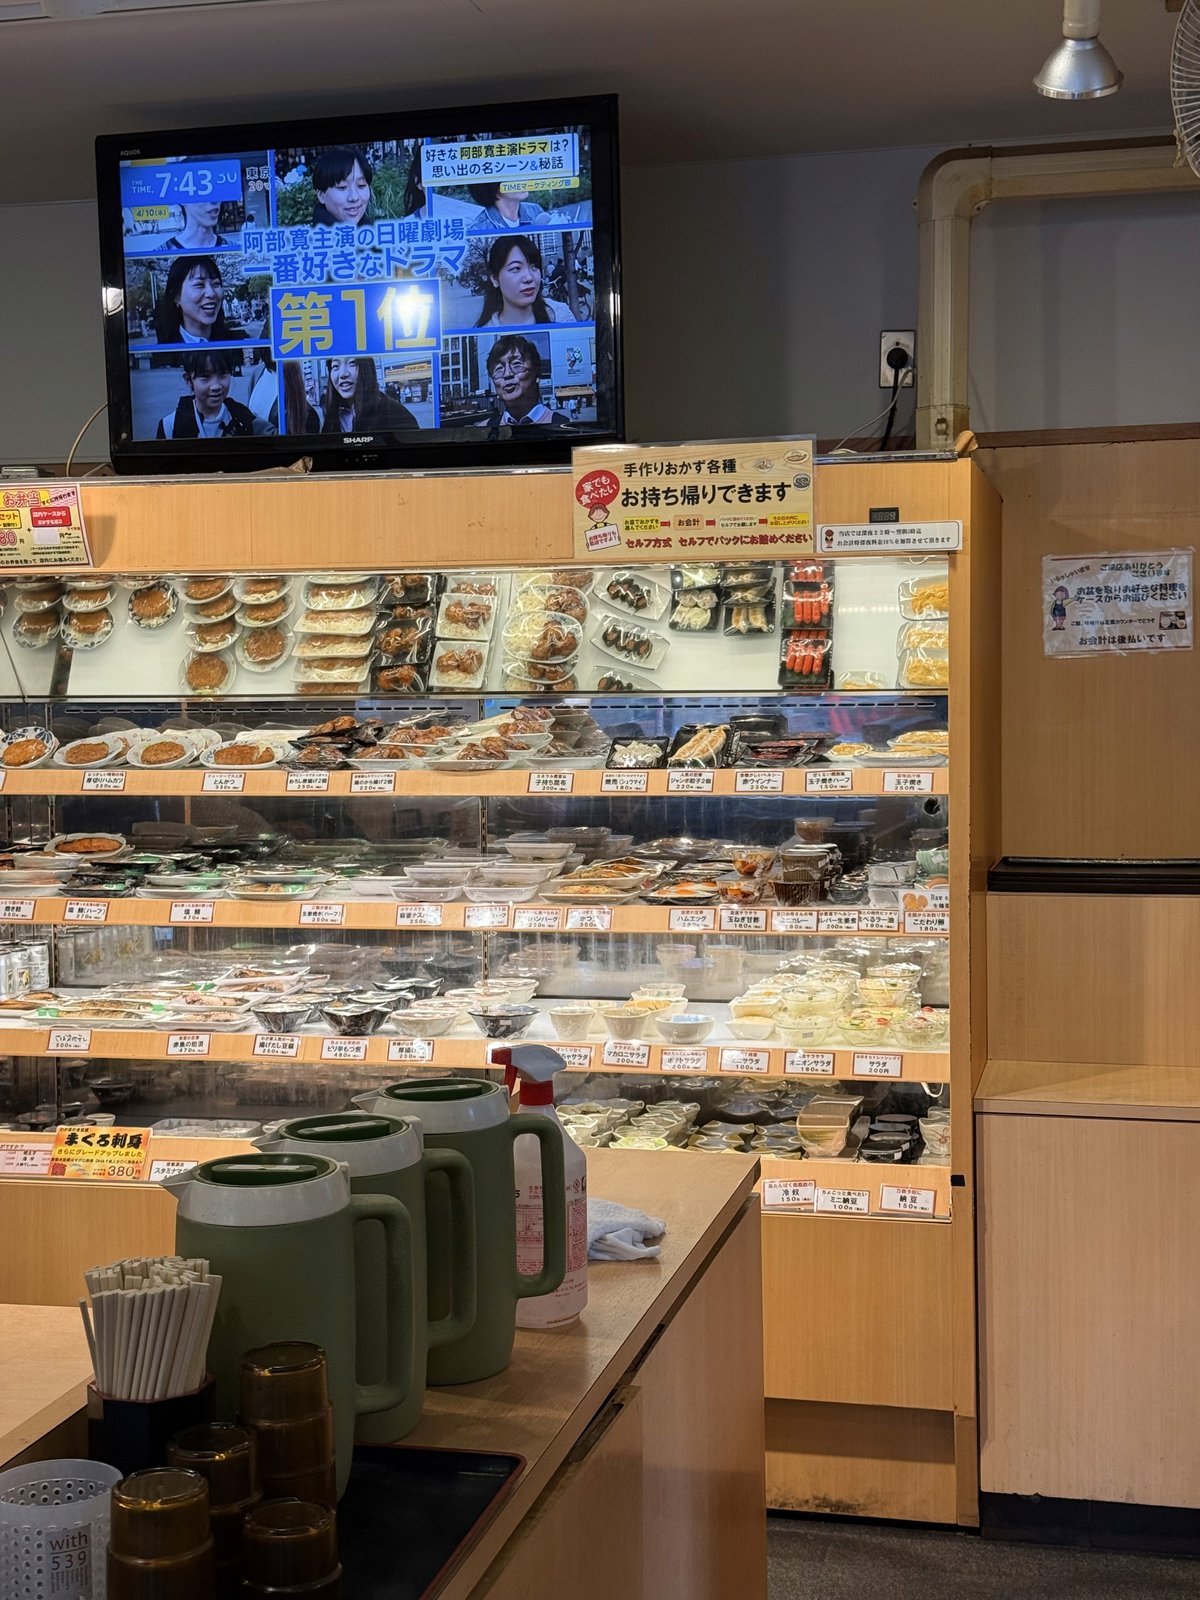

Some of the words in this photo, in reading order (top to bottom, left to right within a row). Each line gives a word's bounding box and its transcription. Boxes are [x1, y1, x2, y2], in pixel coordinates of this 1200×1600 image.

[156, 169, 213, 198] 7:43
[243, 245, 466, 284] 一番好きなドラマ
[276, 284, 437, 355] 第1位
[343, 436, 374, 444] SHARP
[623, 458, 737, 478] 手作りおかず各種
[581, 475, 611, 493] 家でも
[3, 490, 41, 508] お弁当
[580, 484, 618, 506] 食べたい
[621, 482, 792, 508] お持ち帰りできます
[677, 518, 700, 527] お会計
[626, 537, 672, 548] セルフ方式
[1079, 633, 1166, 646] お会計は後払いです
[606, 1050, 647, 1059] マカロニサラダ
[64, 1132, 143, 1149] まぐろ刺身
[49, 1531, 88, 1551] with
[51, 1550, 87, 1571] 539
